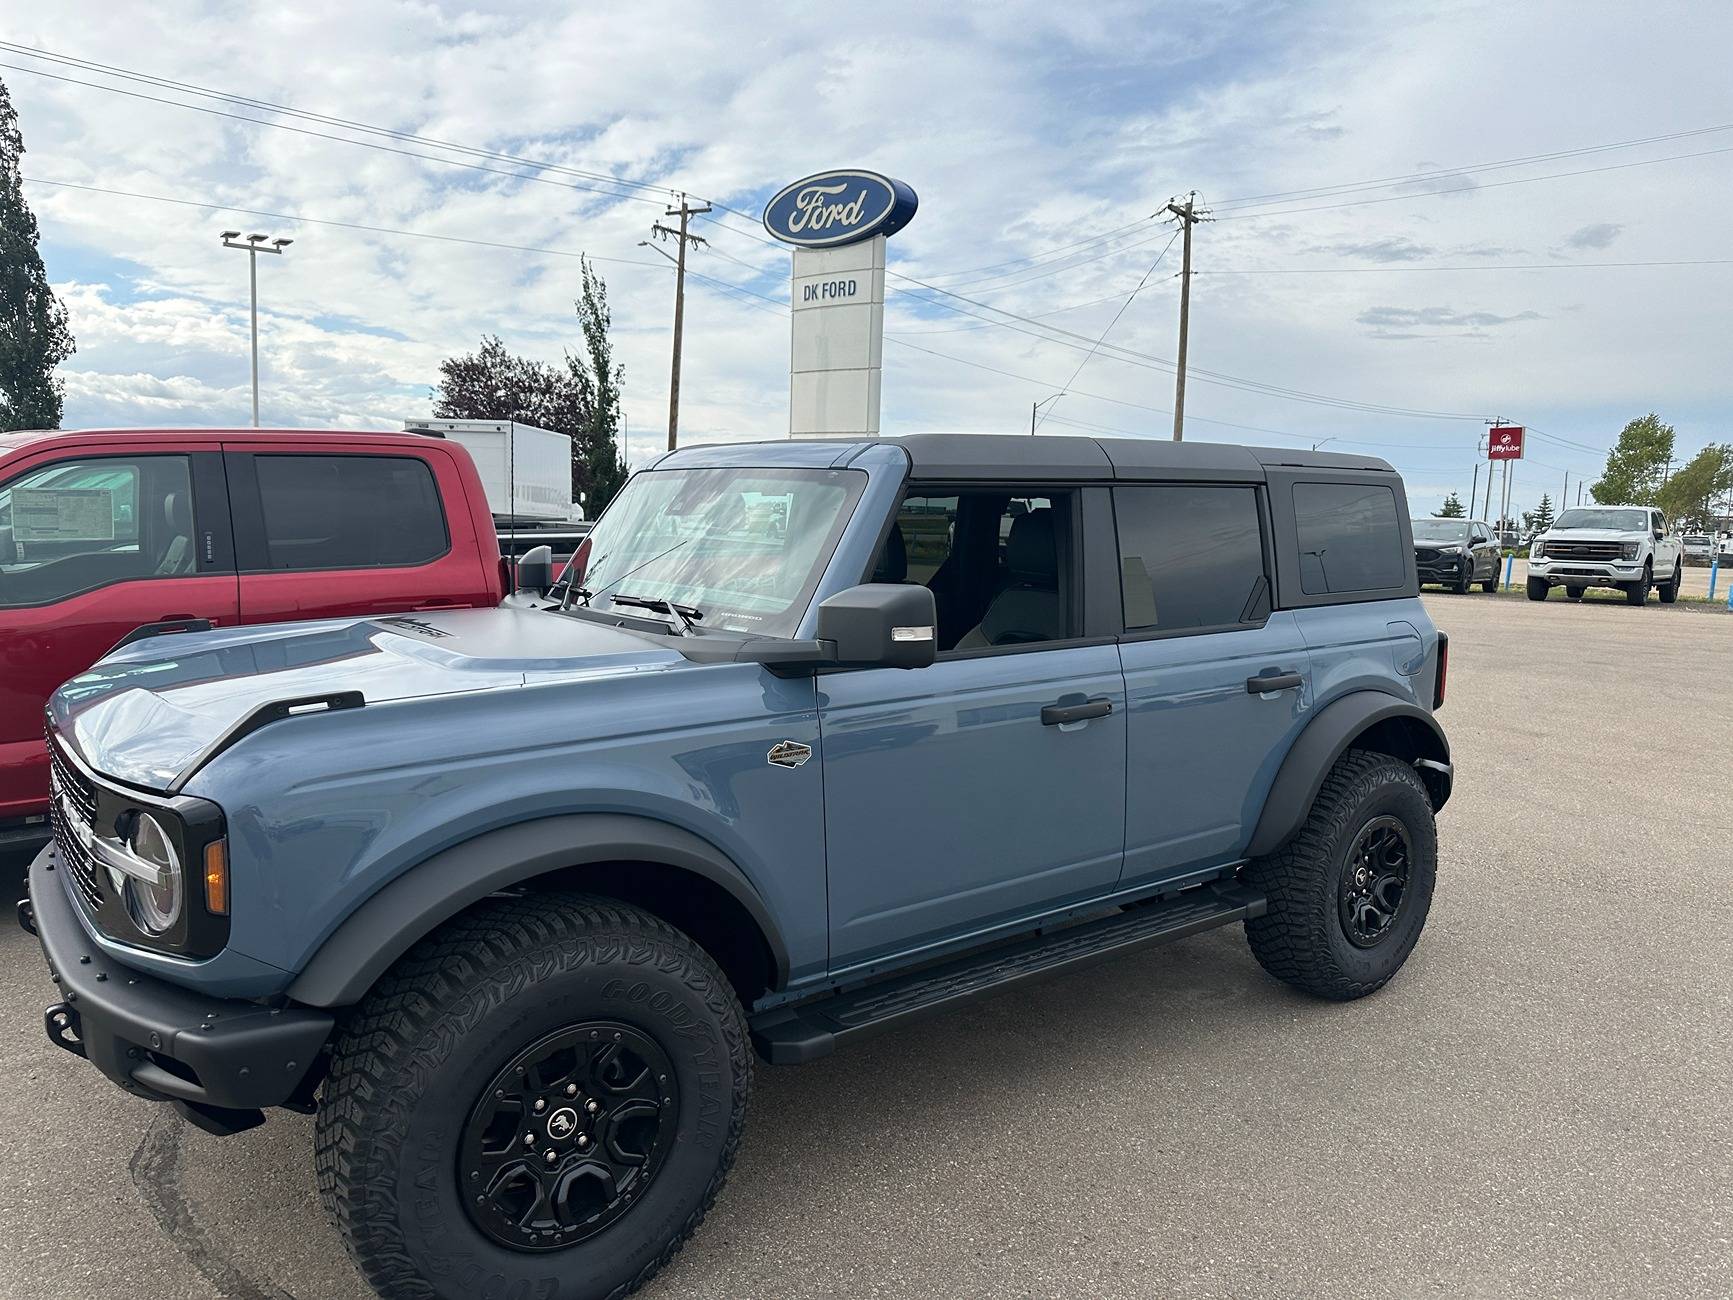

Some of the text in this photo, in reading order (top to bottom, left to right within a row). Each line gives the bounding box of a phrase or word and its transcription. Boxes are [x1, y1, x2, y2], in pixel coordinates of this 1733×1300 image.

[788, 183, 867, 233] Ford
[803, 280, 856, 301] DK FORD
[600, 978, 721, 1149] GOODYEAR
